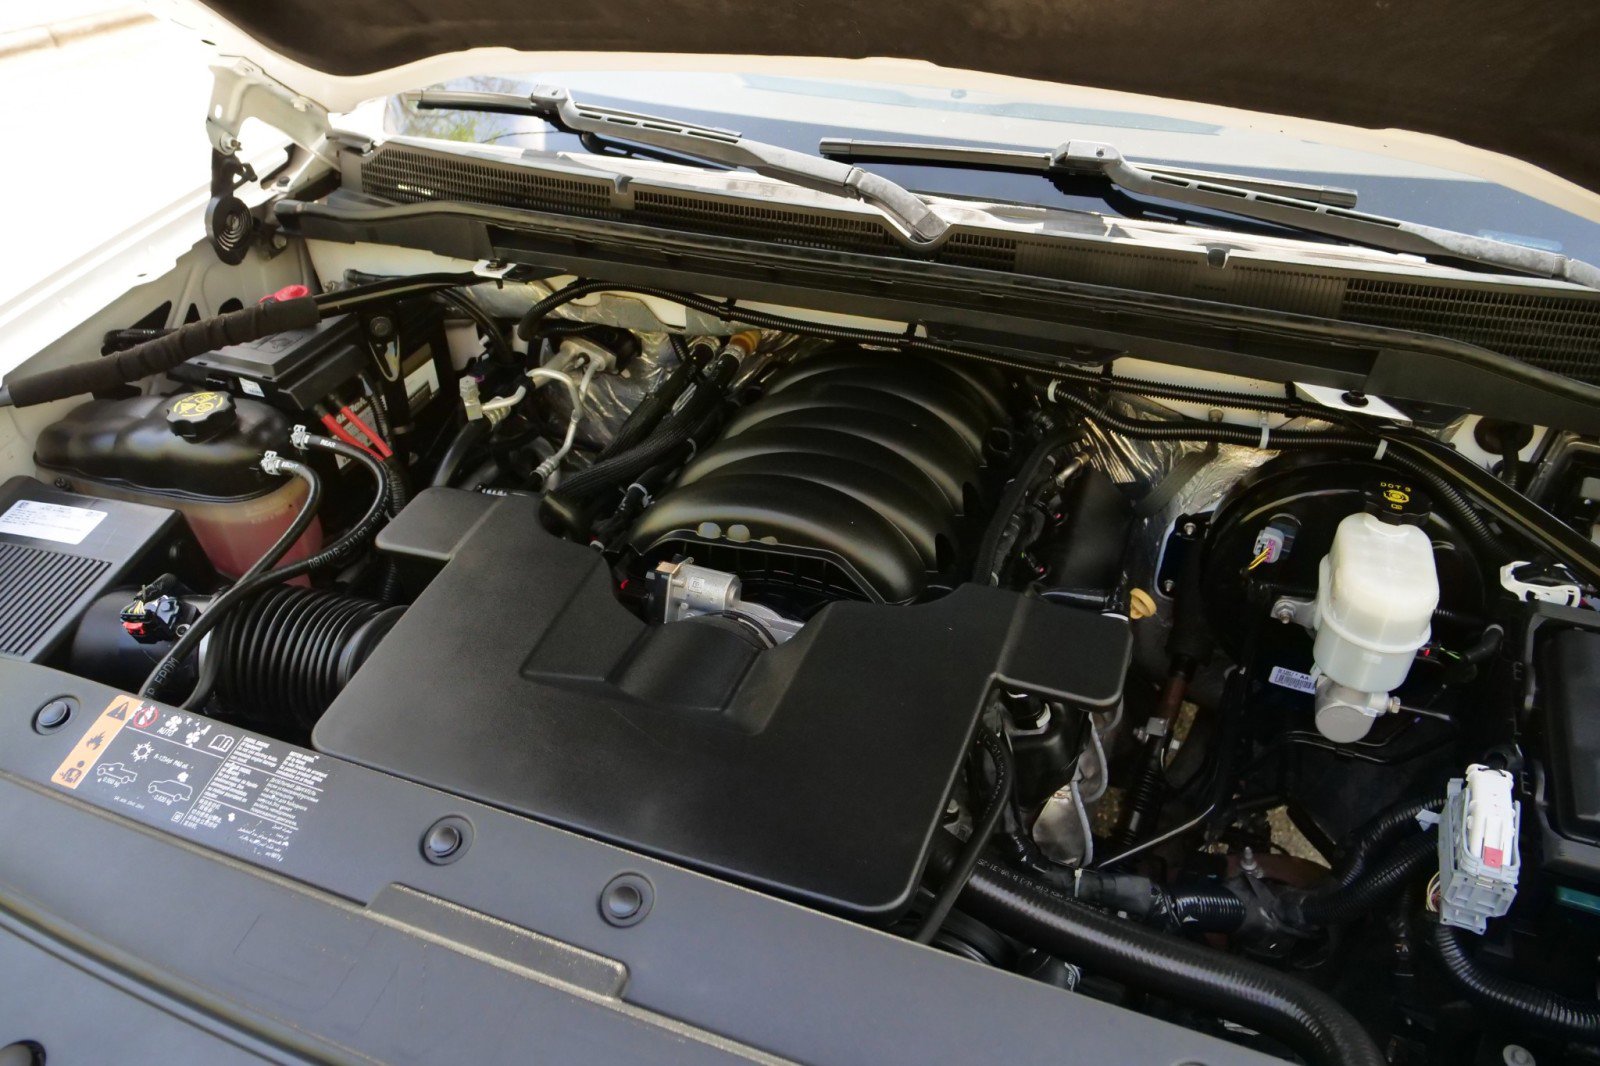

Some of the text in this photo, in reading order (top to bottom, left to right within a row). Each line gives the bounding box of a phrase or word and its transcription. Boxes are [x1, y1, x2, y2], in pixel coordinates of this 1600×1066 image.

[320, 439, 337, 448] REAR
[154, 656, 180, 684] EPDM
[157, 726, 176, 737] AUTO
